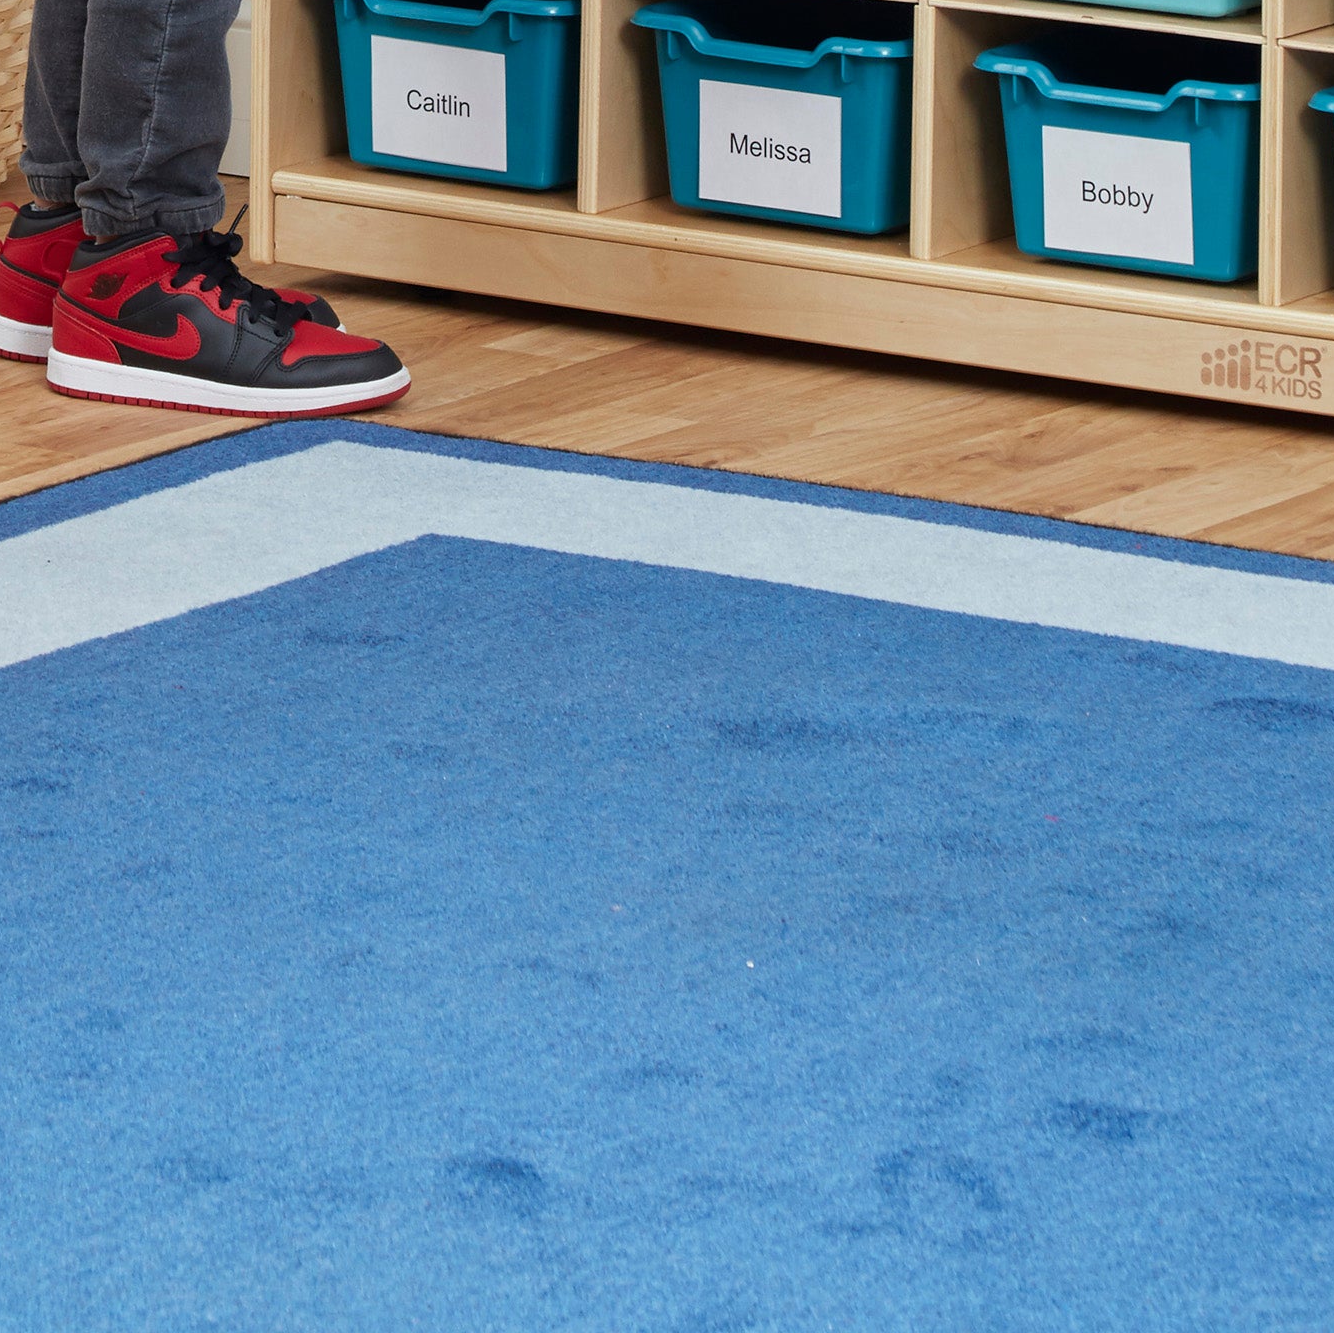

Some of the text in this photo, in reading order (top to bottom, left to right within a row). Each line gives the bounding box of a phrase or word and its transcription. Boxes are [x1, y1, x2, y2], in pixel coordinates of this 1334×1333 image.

[406, 89, 471, 118] Caitlin
[730, 132, 811, 165] Melissa
[1081, 180, 1154, 215] Bobby
[1254, 341, 1323, 379] ECR
